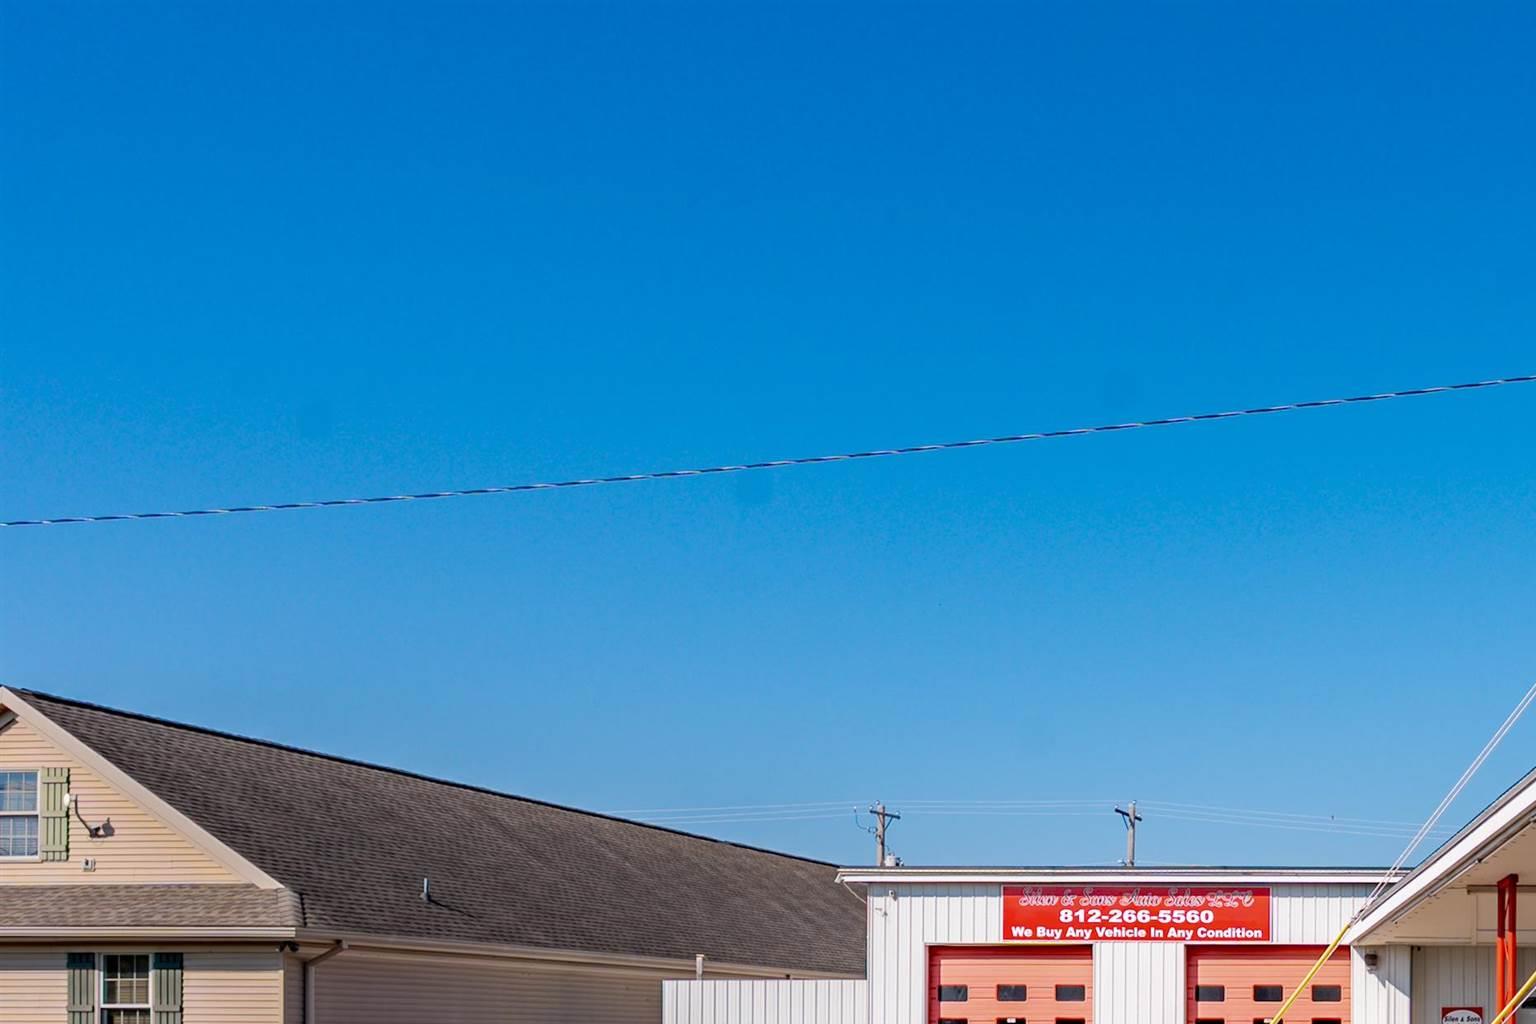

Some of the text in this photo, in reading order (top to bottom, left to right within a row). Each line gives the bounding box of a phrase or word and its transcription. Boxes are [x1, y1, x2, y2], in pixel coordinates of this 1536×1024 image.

[1061, 889, 1077, 906] &
[1079, 887, 1117, 906] Sons
[1119, 888, 1161, 906] Auto
[1163, 887, 1206, 906] Sales
[1059, 909, 1214, 923] 812-266-5560
[1011, 926, 1263, 940] We Buy Any Vehicle In Any Condition
